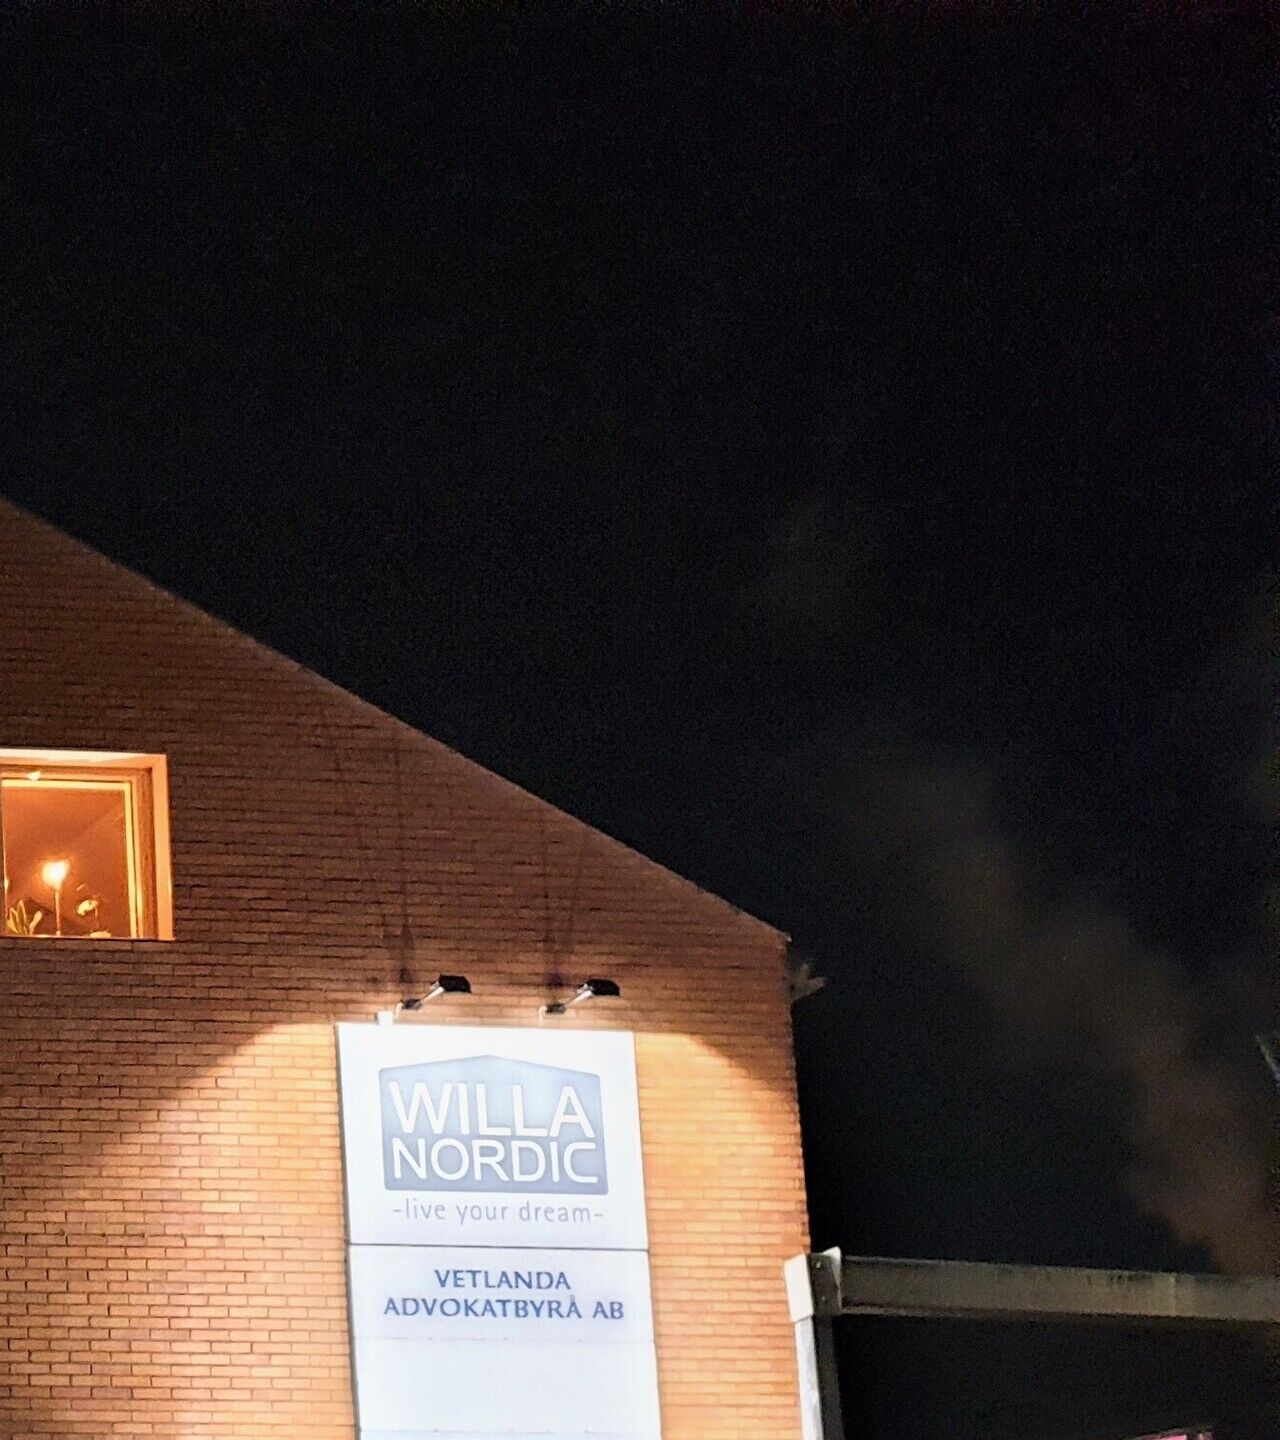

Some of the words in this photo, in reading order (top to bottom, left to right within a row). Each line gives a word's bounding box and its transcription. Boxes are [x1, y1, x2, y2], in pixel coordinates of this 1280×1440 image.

[389, 1082, 595, 1137] WILLA
[392, 1138, 598, 1183] NORDIC
[456, 1203, 508, 1224] your
[434, 1269, 572, 1289] VETLANDA
[383, 1294, 583, 1318] ADVOKATBYRÅ
[593, 1301, 624, 1319] AB
